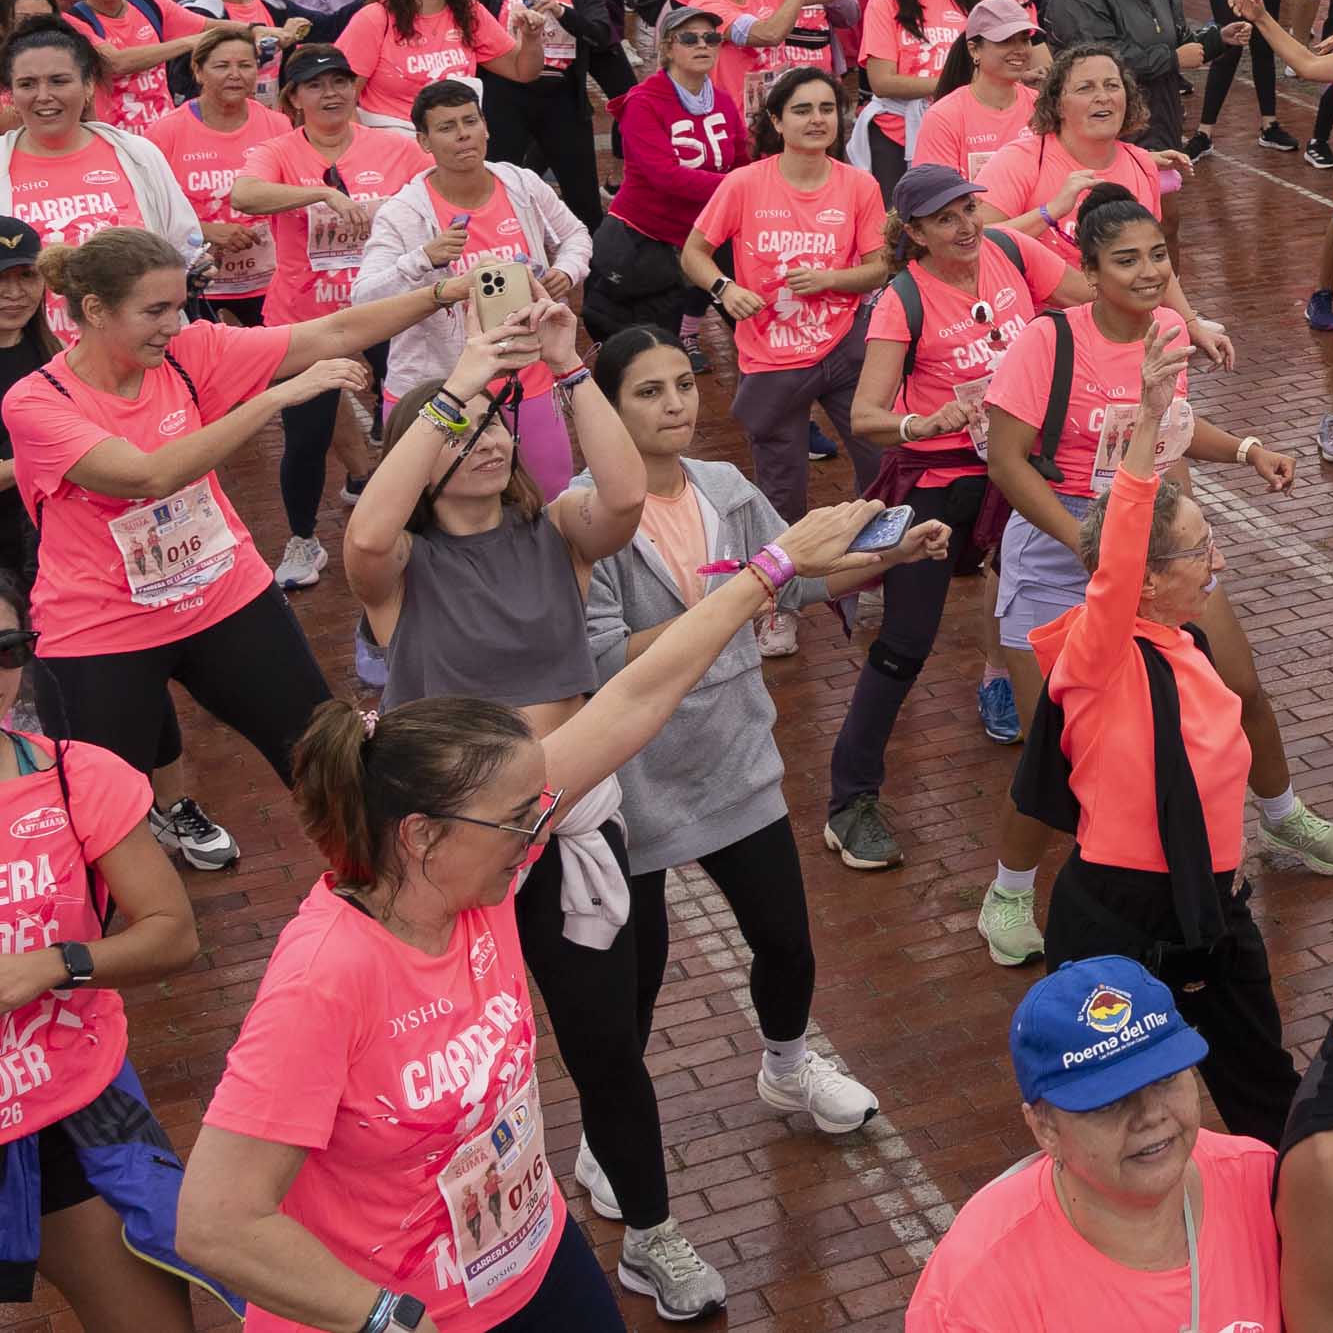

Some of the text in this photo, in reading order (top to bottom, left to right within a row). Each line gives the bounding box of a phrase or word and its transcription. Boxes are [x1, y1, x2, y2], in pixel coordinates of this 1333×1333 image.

[407, 48, 468, 74] CARRERA
[407, 47, 469, 76] CARRERA
[671, 113, 729, 171] SF
[182, 150, 219, 162] OYSHO
[14, 191, 118, 223] CARRERA
[754, 209, 792, 219] OYSHO
[757, 229, 836, 255] CARRERA
[222, 257, 256, 273] 016
[939, 319, 974, 338] OYSHO
[167, 535, 201, 562] 016
[401, 989, 520, 1111] CARRERA
[1062, 1012, 1168, 1069] Poema del Mar
[455, 1152, 489, 1179] SUMA
[509, 1154, 544, 1211] 016
[470, 1246, 508, 1275] CARRERA
[509, 1238, 518, 1249] DE
[518, 1229, 526, 1242] LA
[487, 1261, 517, 1287] OYSHO
